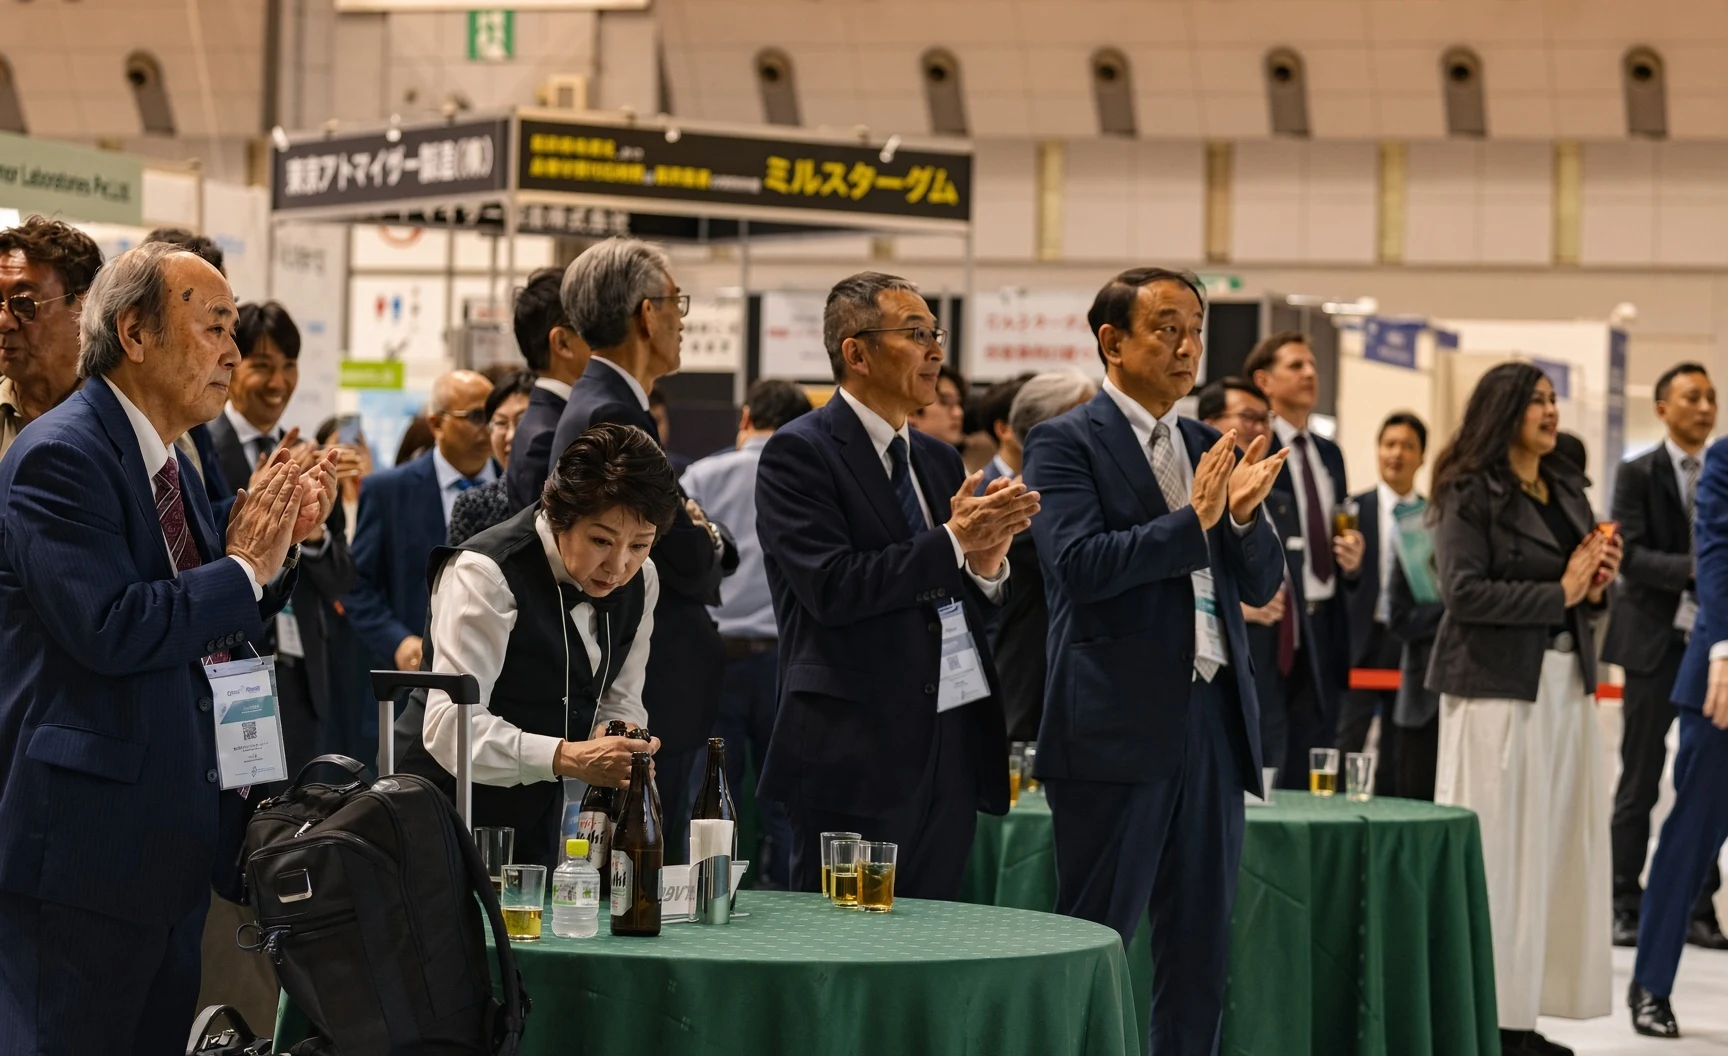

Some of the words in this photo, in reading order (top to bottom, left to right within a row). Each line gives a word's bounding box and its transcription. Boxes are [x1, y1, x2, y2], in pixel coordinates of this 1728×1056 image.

[764, 155, 960, 206] ミルスターグム
